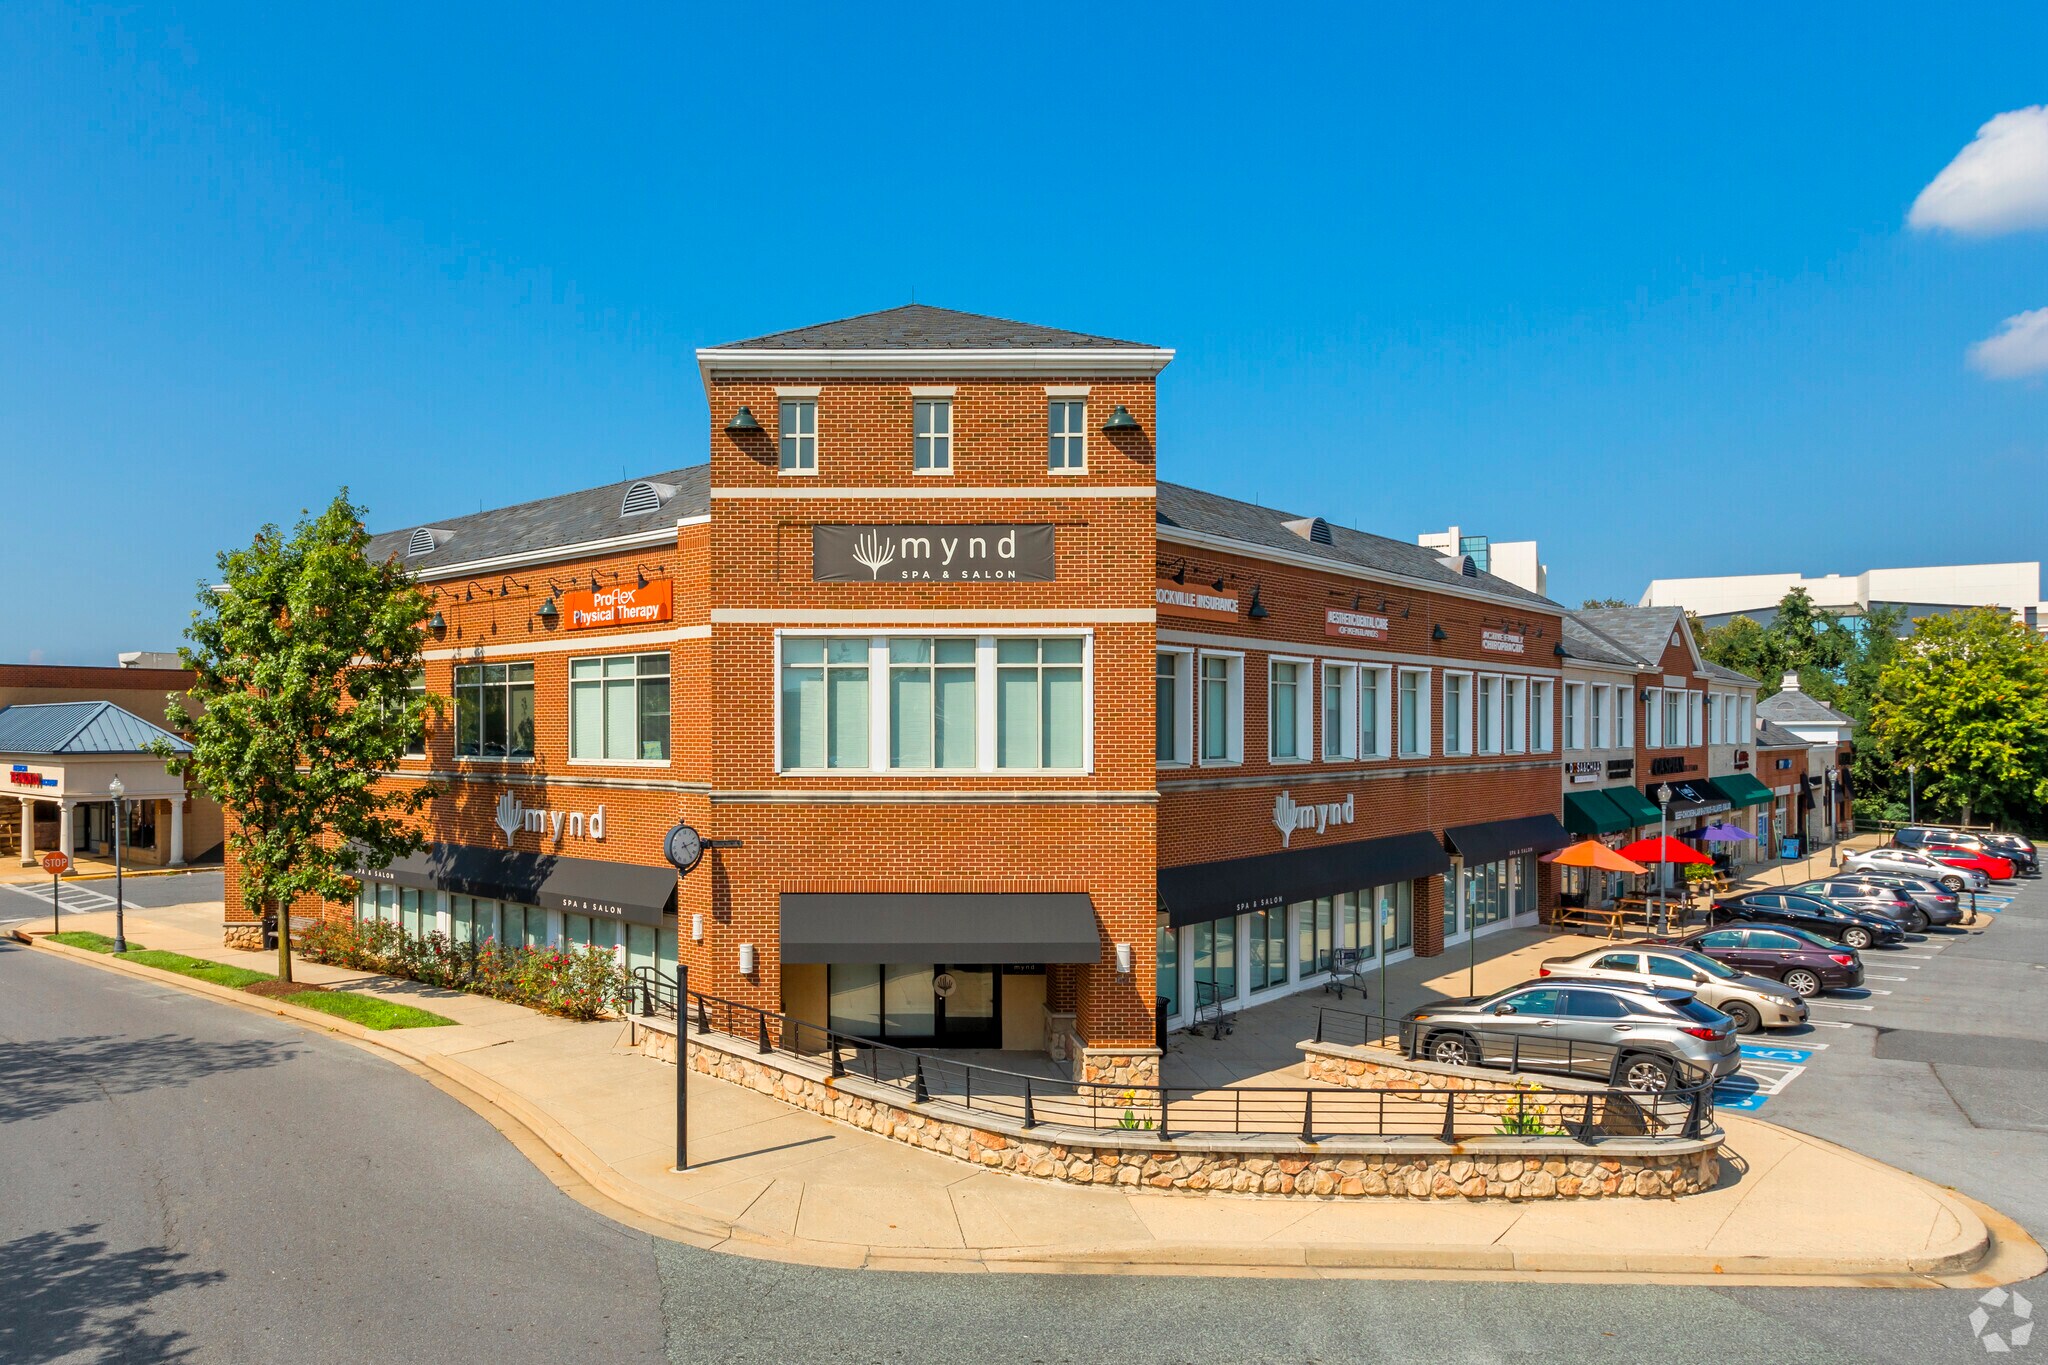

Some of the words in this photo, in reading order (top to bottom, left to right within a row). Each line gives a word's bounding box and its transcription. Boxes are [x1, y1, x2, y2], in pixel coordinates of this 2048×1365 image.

[901, 529, 1016, 566] mynd
[902, 570, 931, 579] SPA
[942, 570, 950, 579] &
[961, 570, 1016, 579] SALON
[1196, 594, 1239, 613] INSURANCE
[573, 607, 615, 626] Physical
[617, 604, 659, 620] Therapy
[1297, 793, 1354, 834] mynd
[525, 804, 606, 842] mynd
[44, 858, 67, 868] STOP
[374, 871, 394, 879] SALON
[562, 899, 578, 908] SPA
[592, 903, 622, 915] SALON
[1236, 902, 1249, 911] SPA
[1261, 896, 1283, 906] SALON
